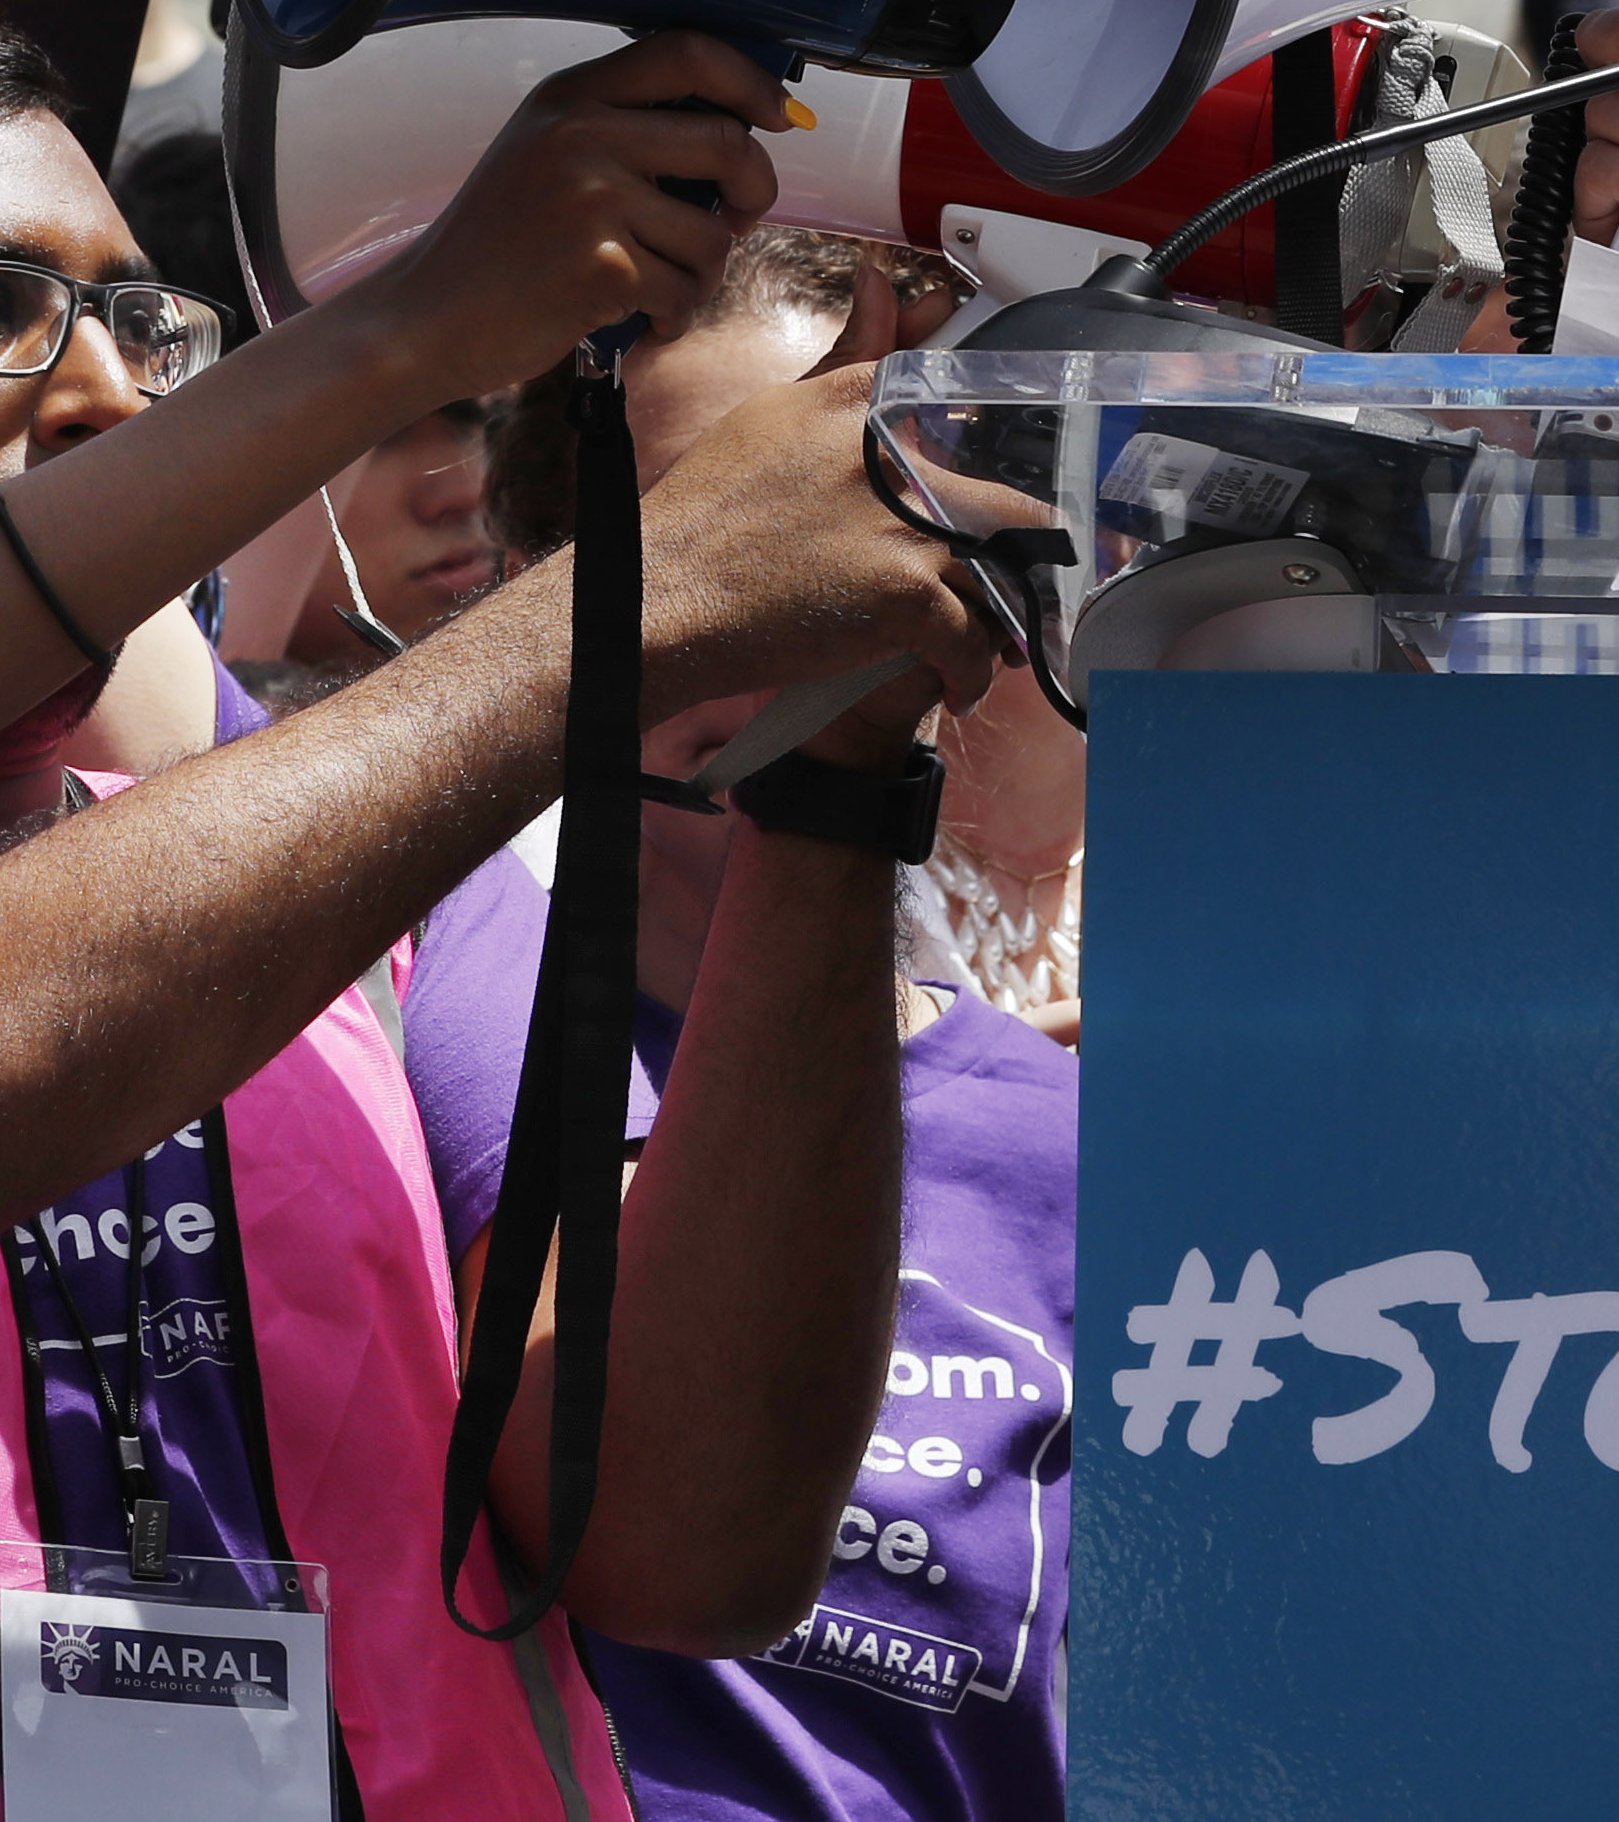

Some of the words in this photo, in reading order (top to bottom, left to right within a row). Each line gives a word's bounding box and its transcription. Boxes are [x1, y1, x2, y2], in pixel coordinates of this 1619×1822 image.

[114, 1639, 272, 1684] NARAL
[820, 1620, 960, 1688] NARAL
[115, 1677, 202, 1694] PRO-CHOICE
[210, 1684, 274, 1698] AMERICA
